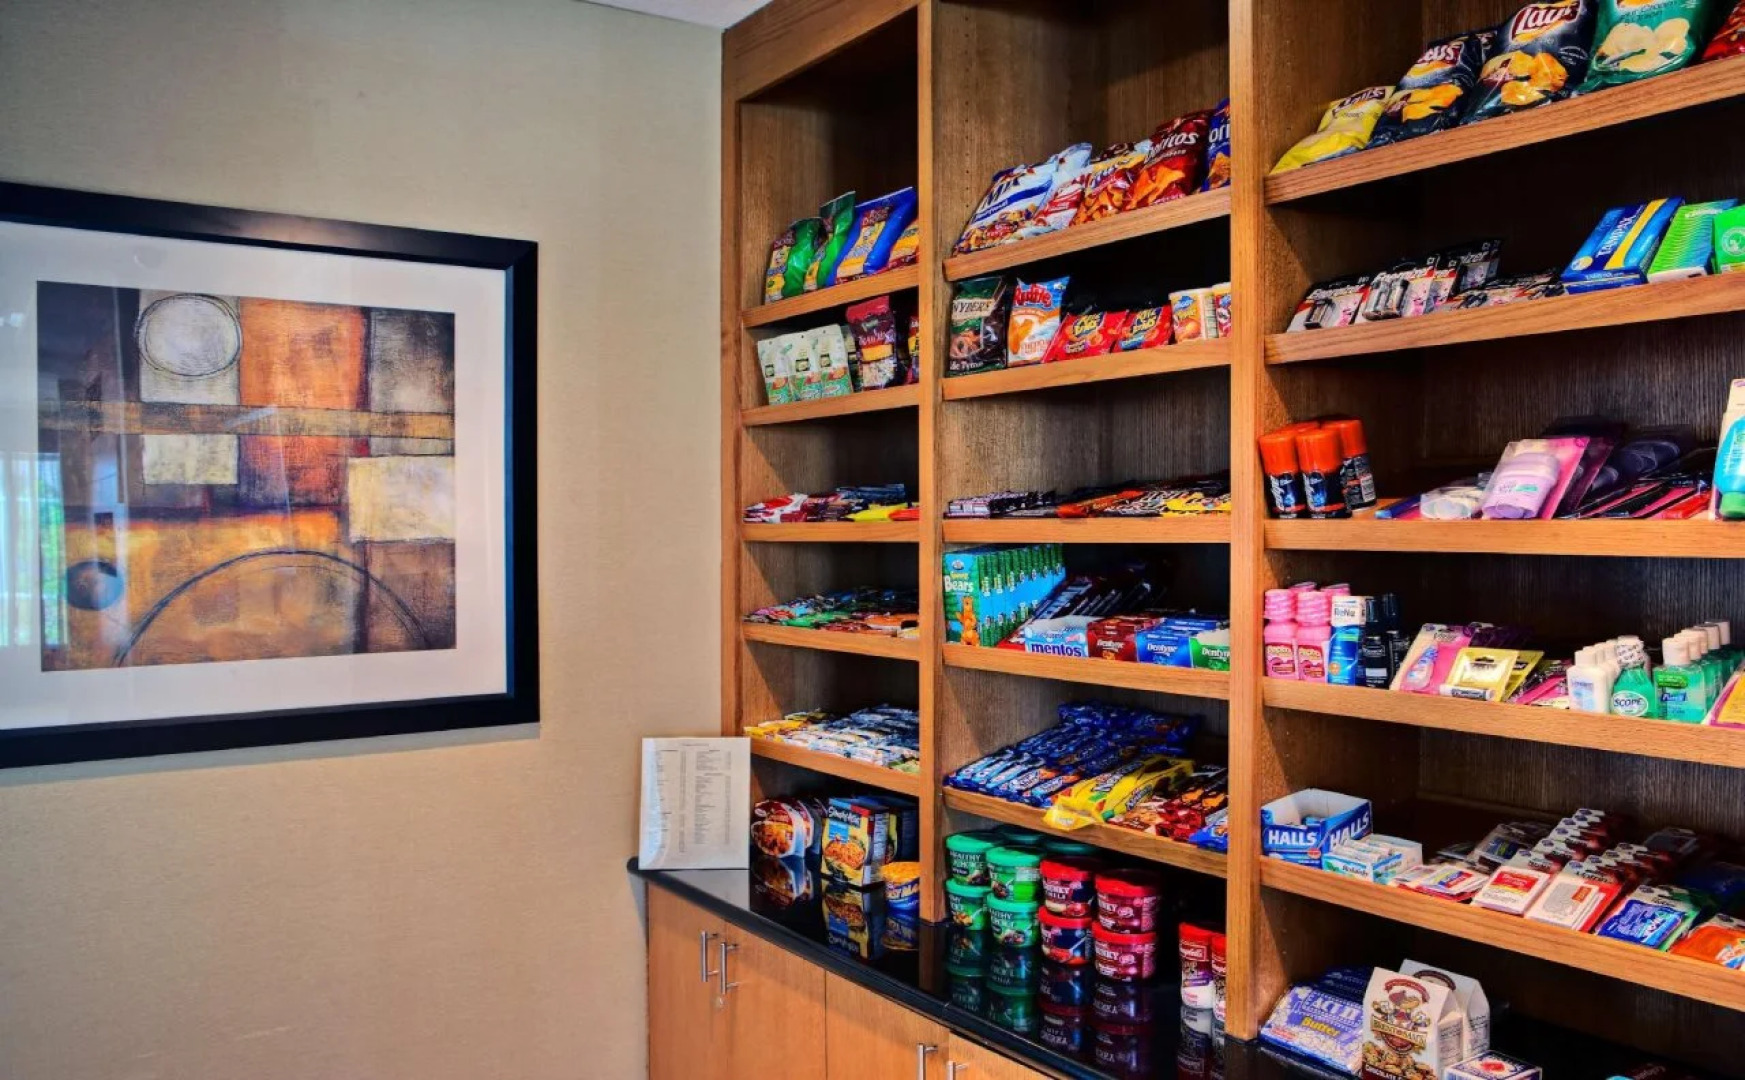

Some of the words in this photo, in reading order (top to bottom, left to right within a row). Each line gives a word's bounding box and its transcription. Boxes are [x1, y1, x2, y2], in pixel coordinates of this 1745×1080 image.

[1514, 6, 1574, 34] Lay's
[943, 575, 973, 593] Bears
[1030, 642, 1082, 657] mentos
[1147, 642, 1178, 654] Dentyne
[1613, 697, 1643, 708] SCOPE
[1268, 829, 1318, 846] HALLS
[1330, 811, 1370, 848] HALLS
[1311, 996, 1341, 1015] ACT
[1301, 1016, 1340, 1037] Butter
